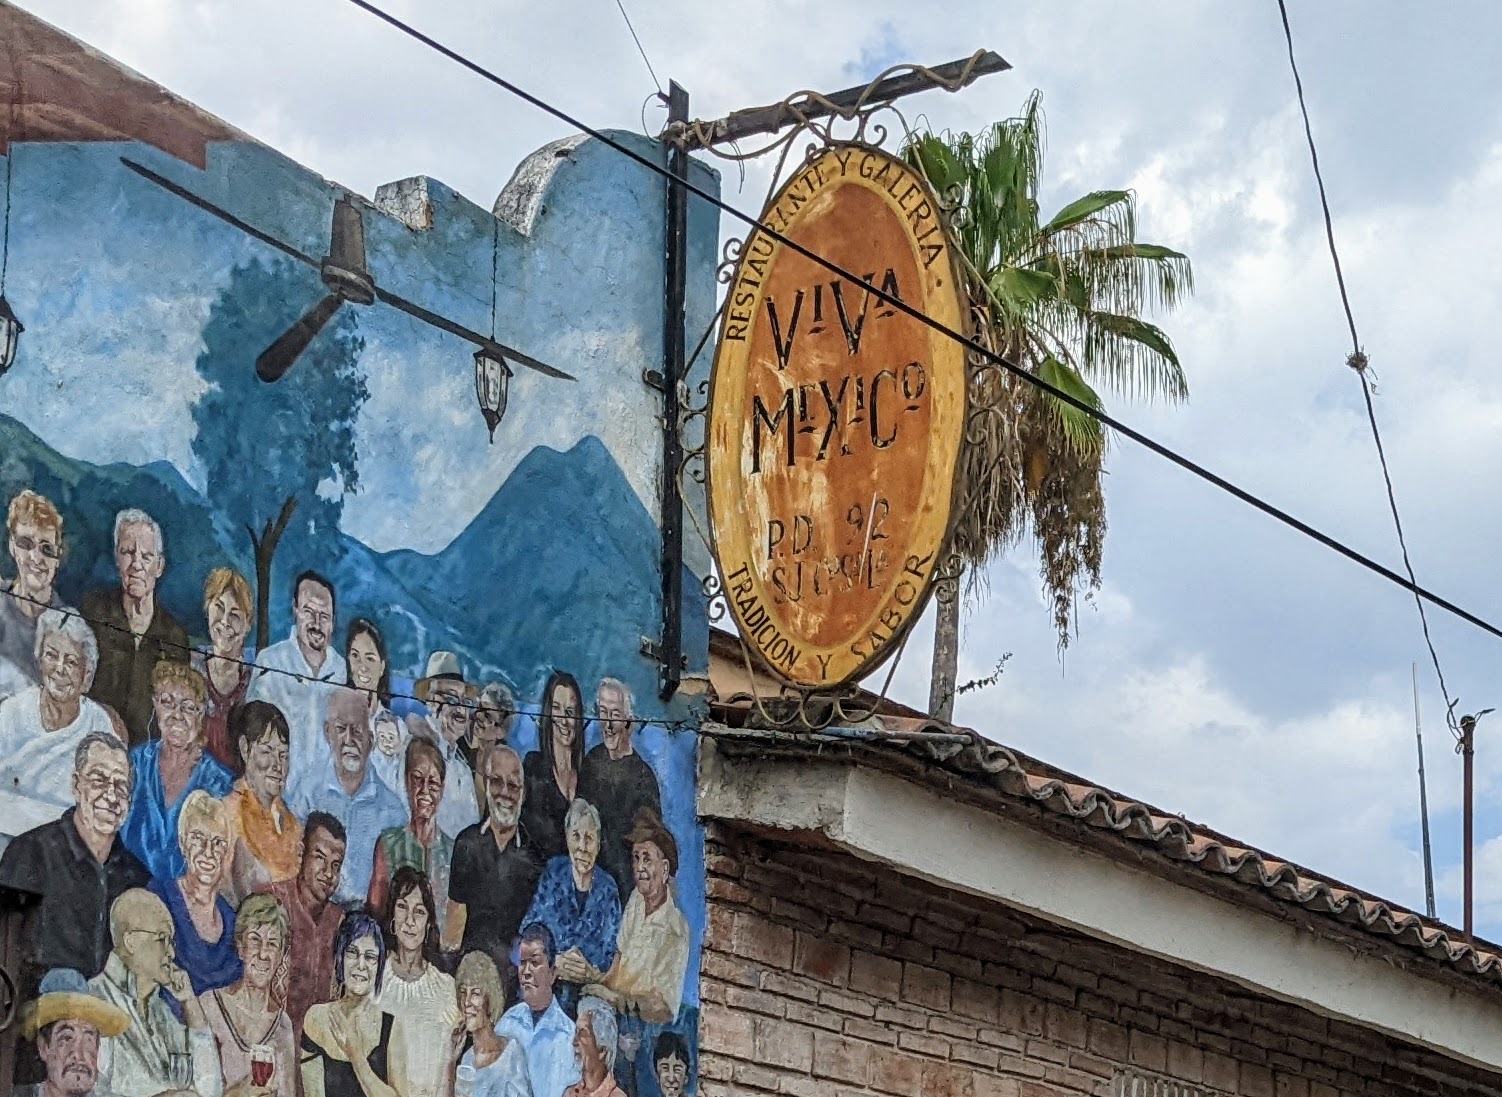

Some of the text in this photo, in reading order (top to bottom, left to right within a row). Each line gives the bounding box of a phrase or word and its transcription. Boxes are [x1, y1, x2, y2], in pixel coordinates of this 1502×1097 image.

[725, 151, 944, 342] RESTAURANTE Y GALERIA
[765, 268, 903, 371] VIVA
[728, 550, 935, 681] TRADICION Y SABOR
